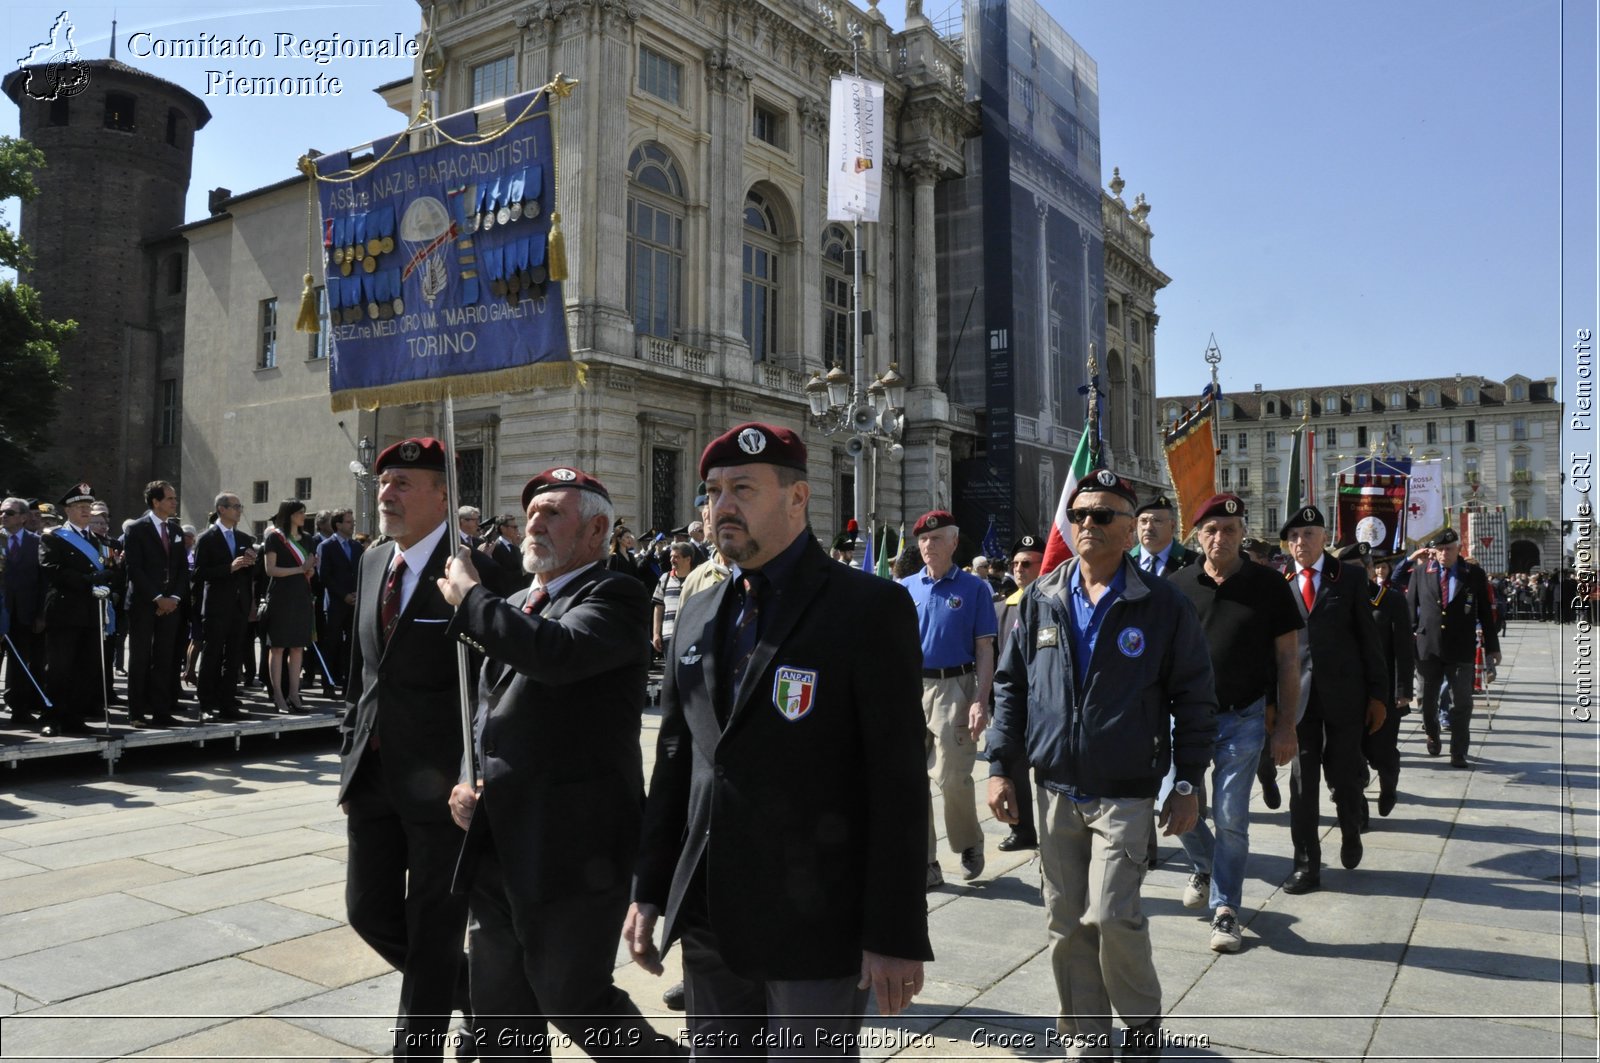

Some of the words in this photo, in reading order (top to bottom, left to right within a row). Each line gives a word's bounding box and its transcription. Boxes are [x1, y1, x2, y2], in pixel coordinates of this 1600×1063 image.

[865, 99, 874, 136] VINCI
[418, 136, 538, 188] PARACADUTISTI
[865, 140, 874, 158] DA
[400, 313, 420, 333] ORO
[406, 331, 477, 358] TORINO
